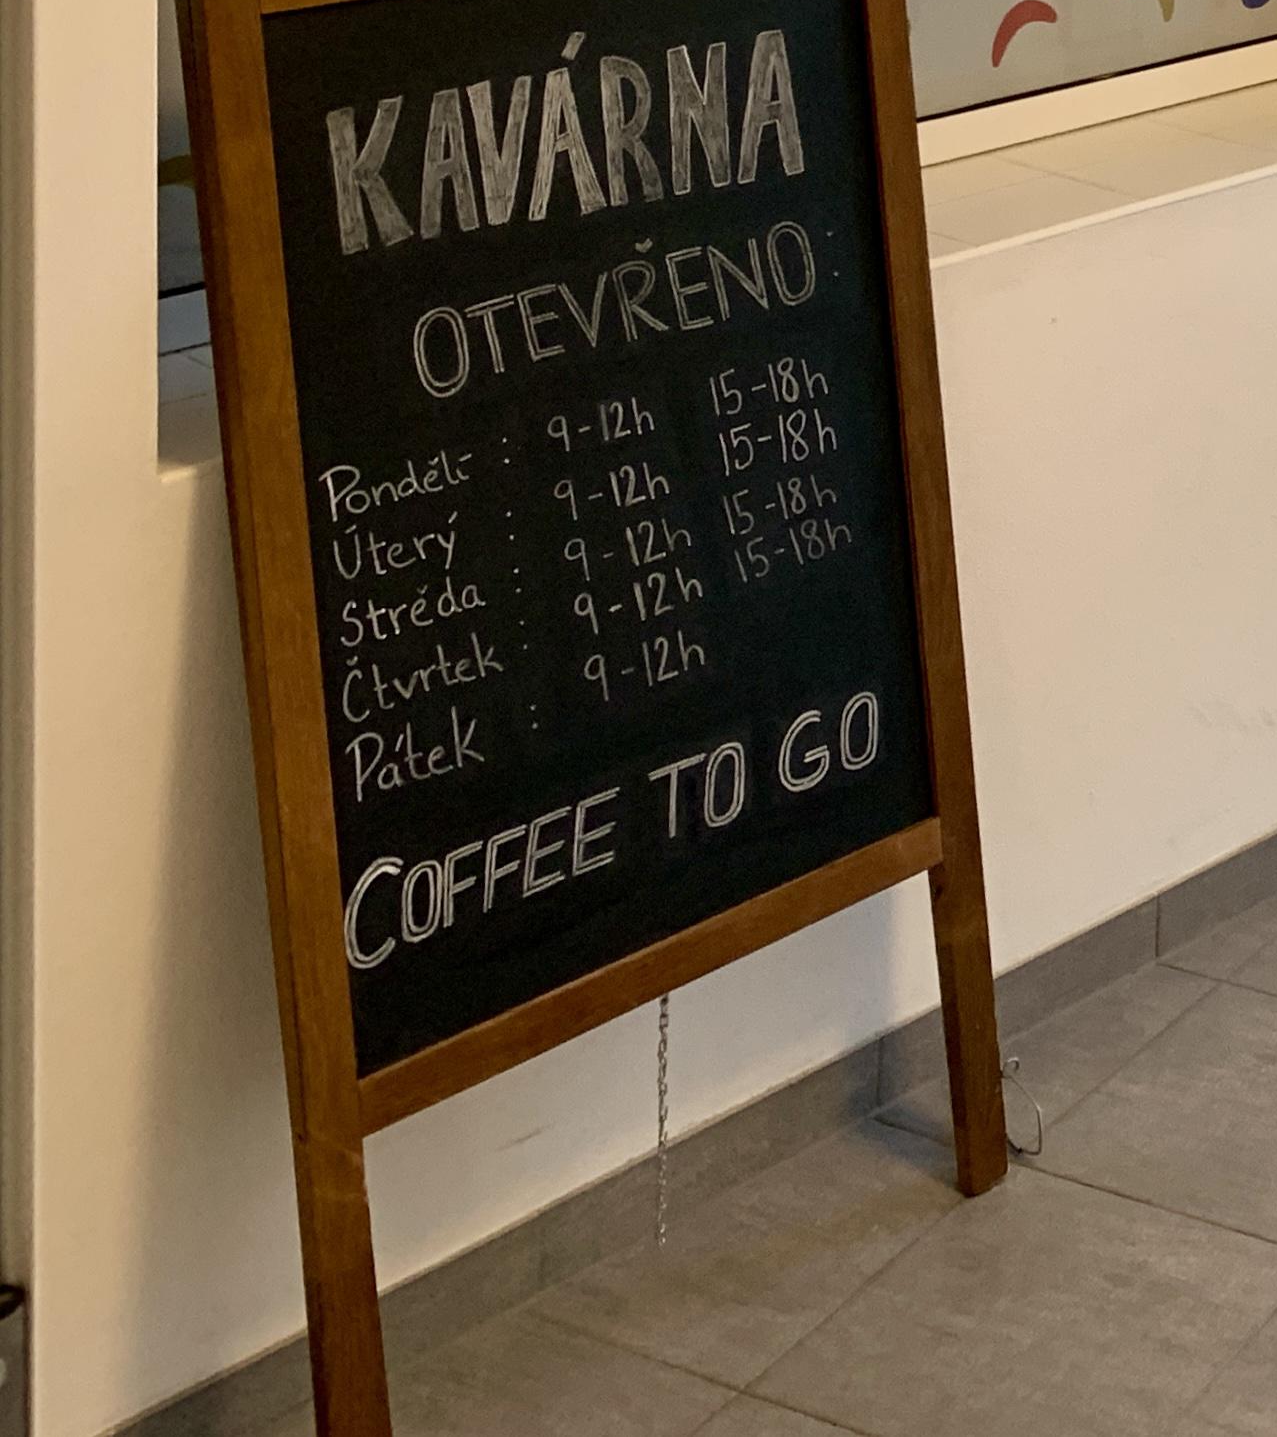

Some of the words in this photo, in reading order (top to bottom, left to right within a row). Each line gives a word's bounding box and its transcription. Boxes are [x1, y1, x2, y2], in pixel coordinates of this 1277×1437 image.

[326, 31, 804, 255] KAVÁRNA
[343, 786, 621, 968] COFFEE
[648, 740, 746, 838] TO
[777, 691, 879, 793] GO
[345, 706, 485, 802] Pátek
